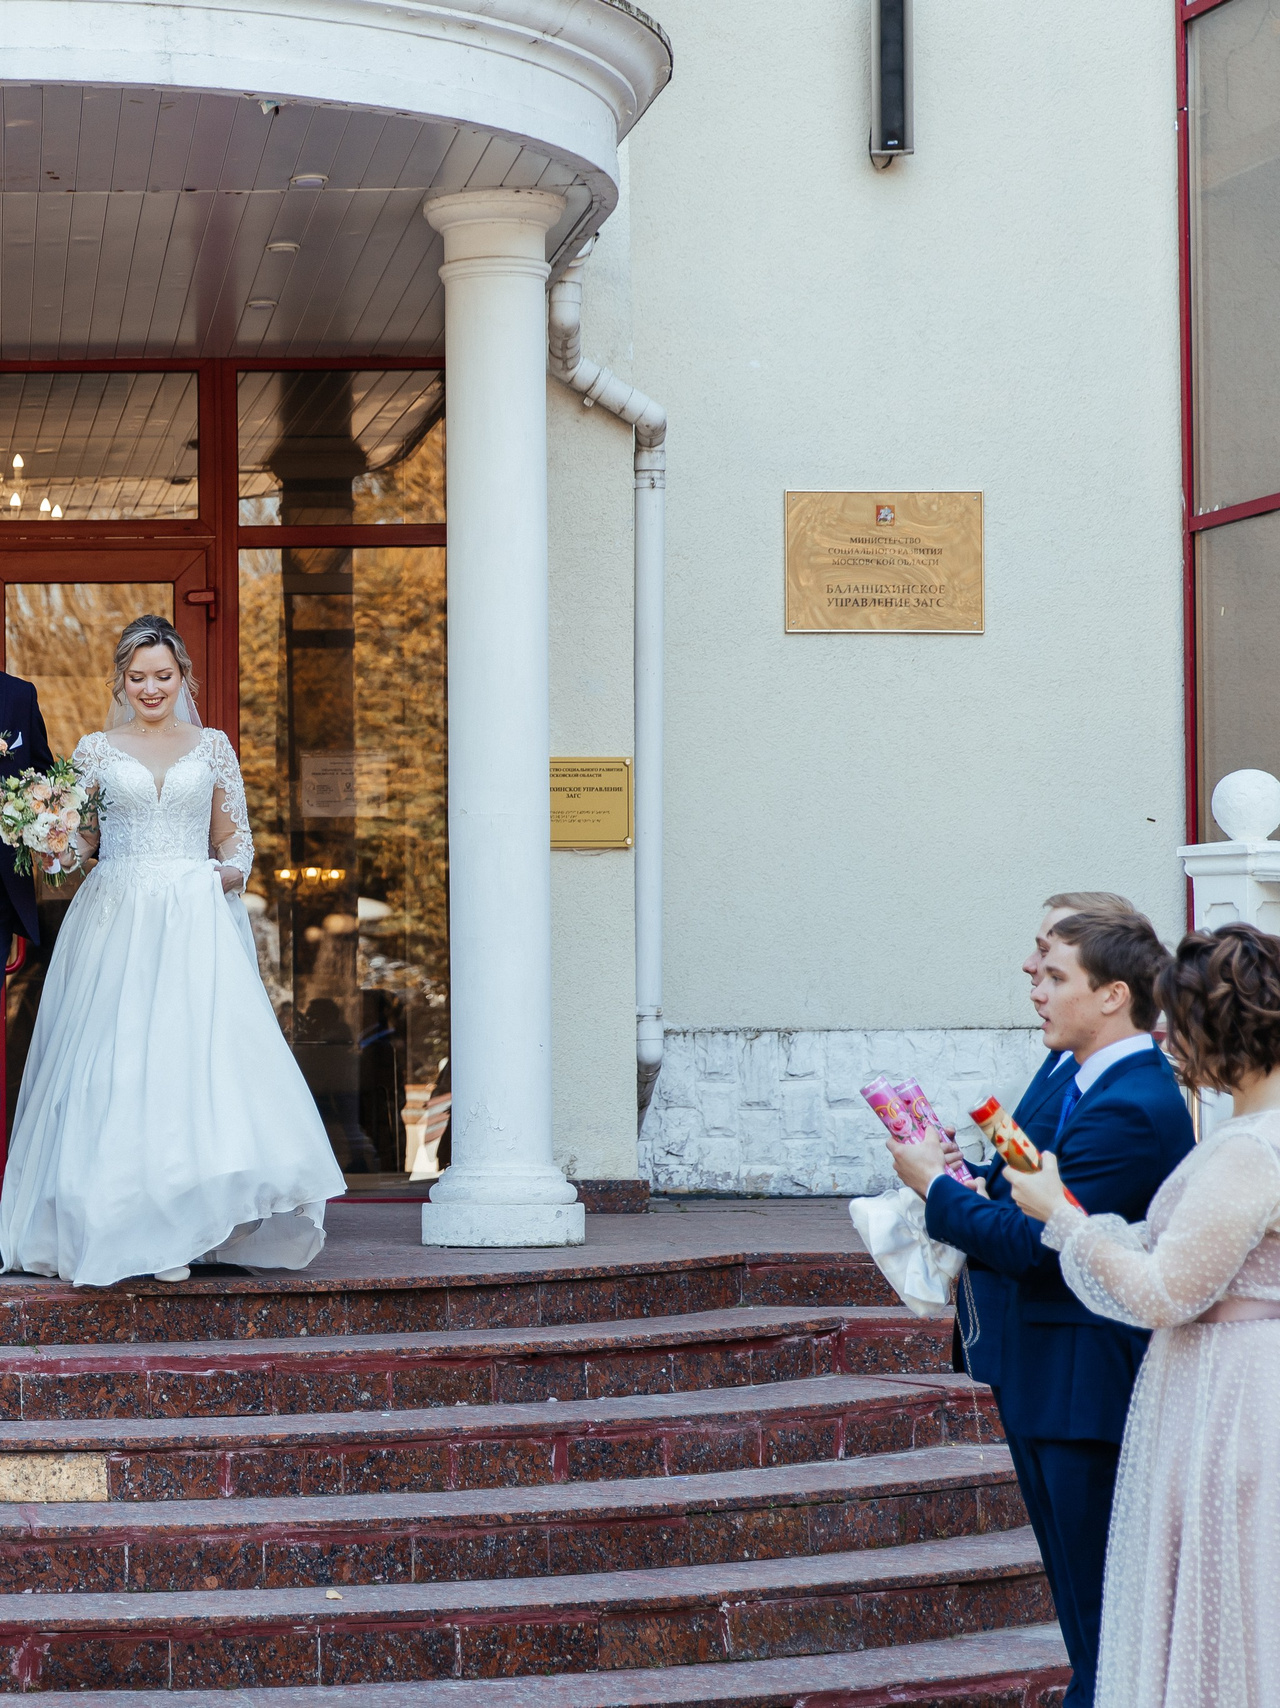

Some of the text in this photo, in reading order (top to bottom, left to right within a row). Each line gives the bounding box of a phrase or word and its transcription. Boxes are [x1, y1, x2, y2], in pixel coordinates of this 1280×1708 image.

[849, 536, 922, 545] МИНИСТЕРСТВО
[827, 547, 943, 555] СОЦИАЛЬНОГО РАЗВИТИЯ
[831, 557, 940, 566] МОСКОВСКОЙ ОБЛАСТИ
[825, 584, 946, 595] БАЛАШИХИНСКОЕ
[826, 597, 946, 608] УПРАВЛЕНИЕ ЗАГС
